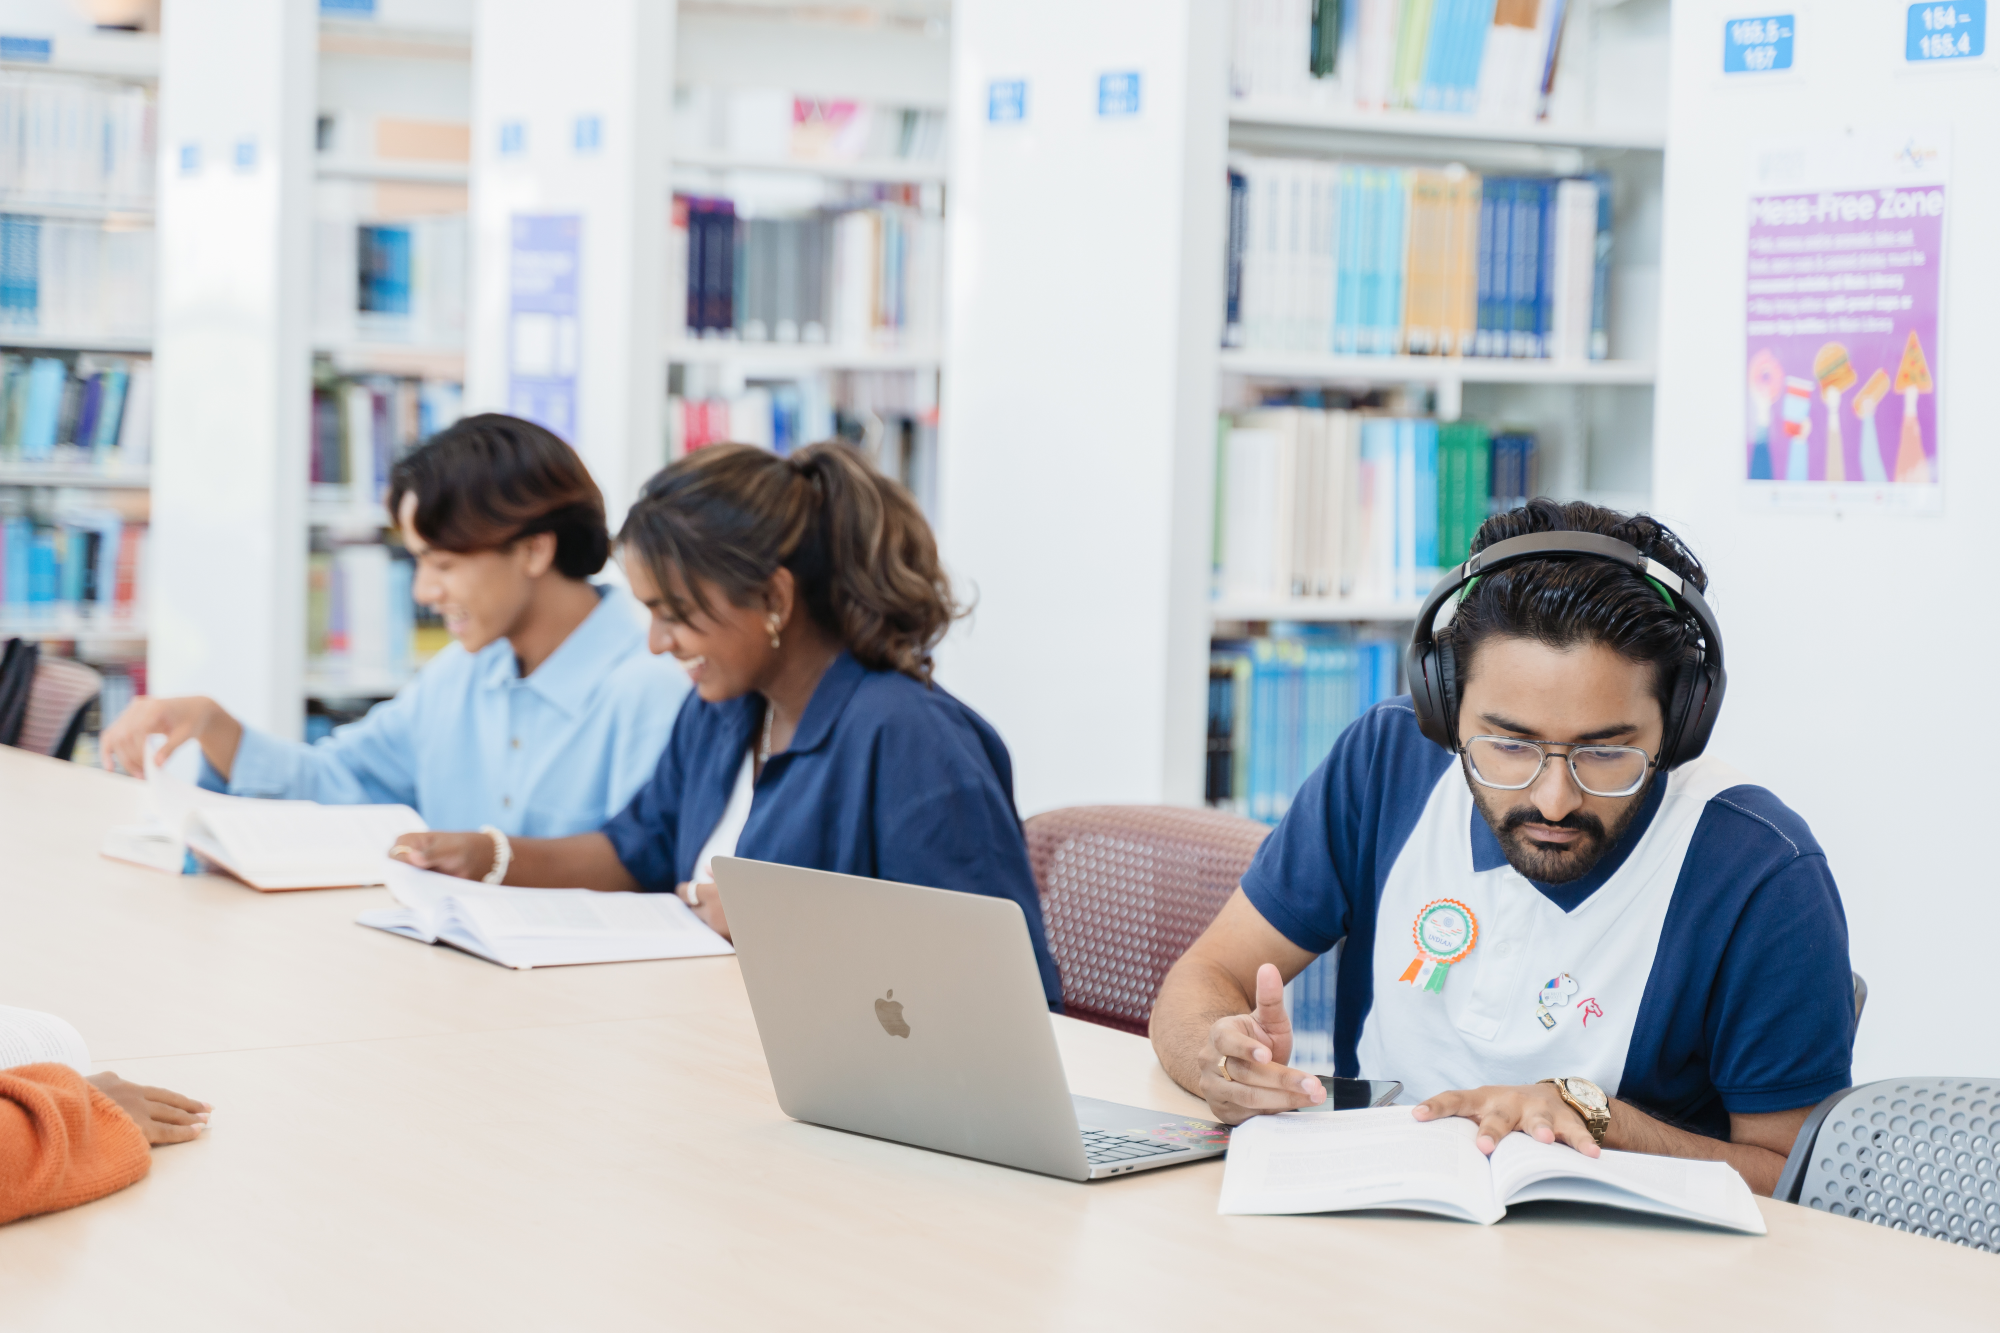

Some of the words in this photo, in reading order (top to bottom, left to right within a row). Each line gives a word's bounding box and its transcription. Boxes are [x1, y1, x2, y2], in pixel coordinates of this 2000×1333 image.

[1749, 193, 1876, 227] Mess-Free
[1877, 188, 1945, 220] Zone
[1428, 934, 1452, 948] INDIAN
